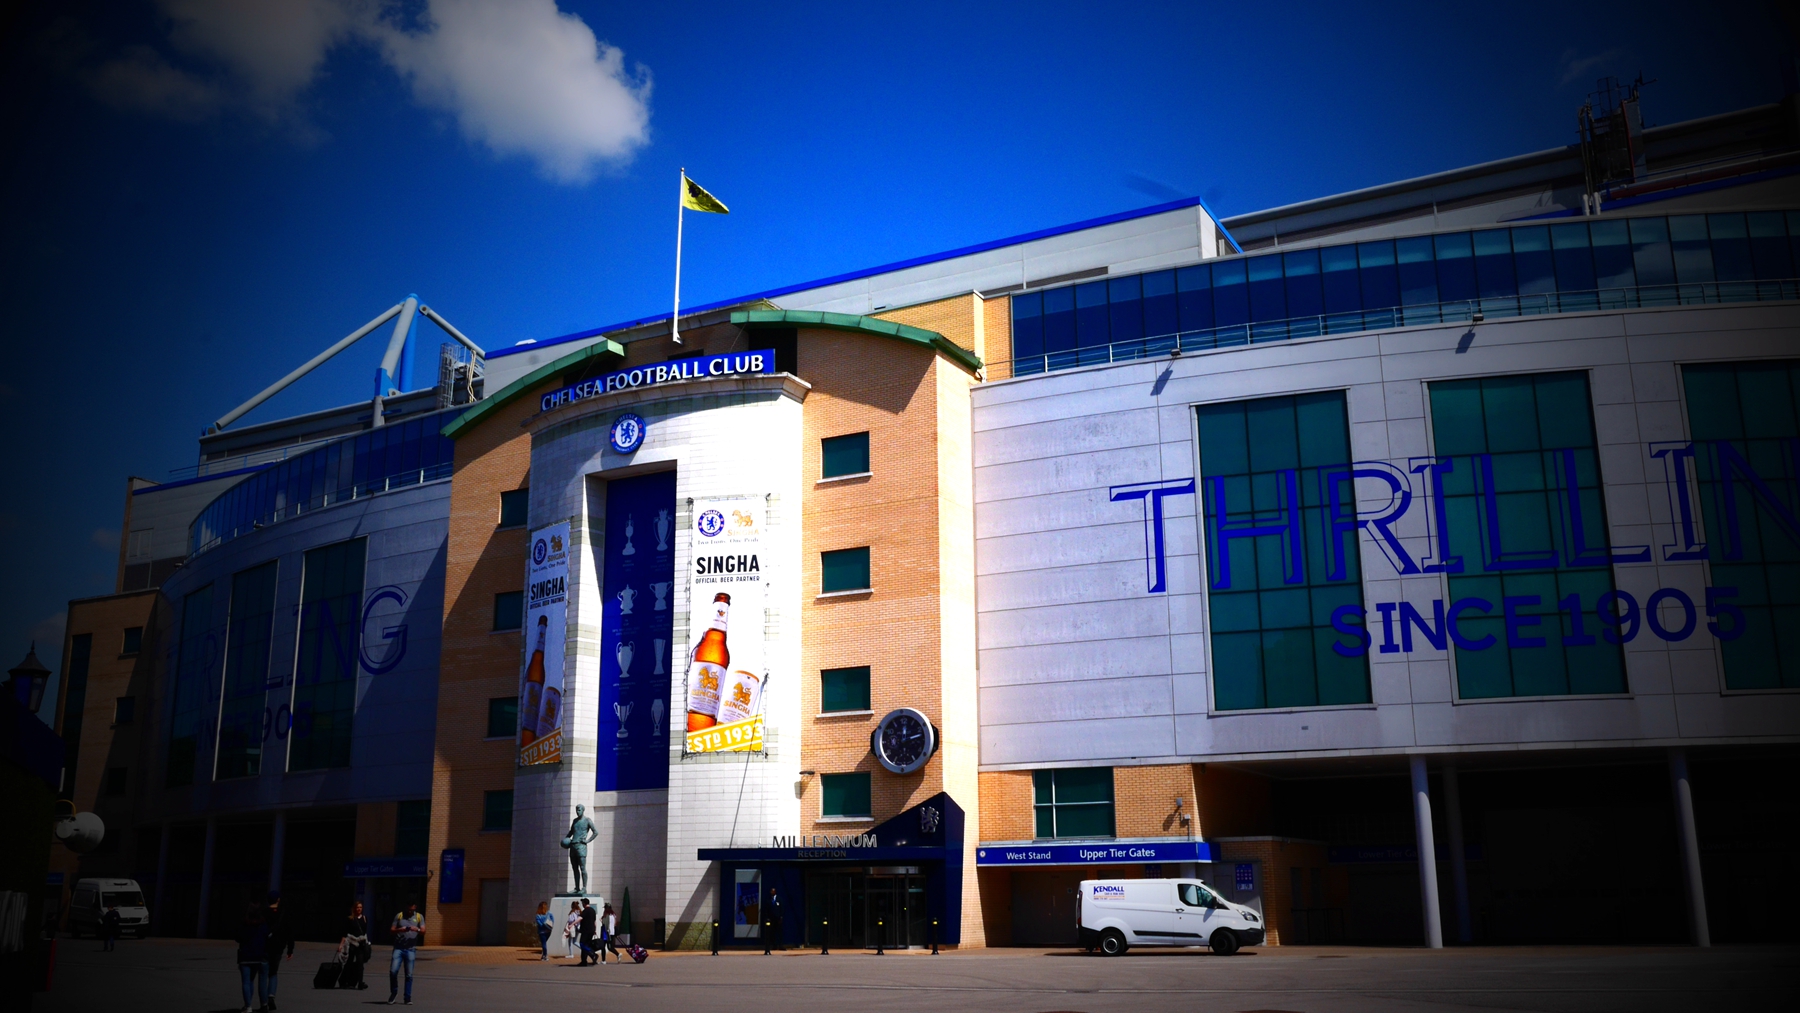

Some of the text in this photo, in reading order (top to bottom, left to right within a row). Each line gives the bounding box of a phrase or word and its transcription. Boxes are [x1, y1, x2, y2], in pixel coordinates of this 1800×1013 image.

[541, 354, 764, 411] CHELSEA FOOTBALL CLUB
[696, 554, 760, 575] SINGHA
[530, 576, 565, 601] SINGHA
[1330, 586, 1747, 658] SINCE 1905
[724, 722, 763, 745] 1933
[539, 736, 563, 756] 1933
[772, 833, 878, 848] MILLENNIUM
[797, 850, 847, 858] RECEPTION
[1006, 847, 1156, 861] West Stand Upper Tier Gates
[1093, 885, 1125, 895] KENDALL
